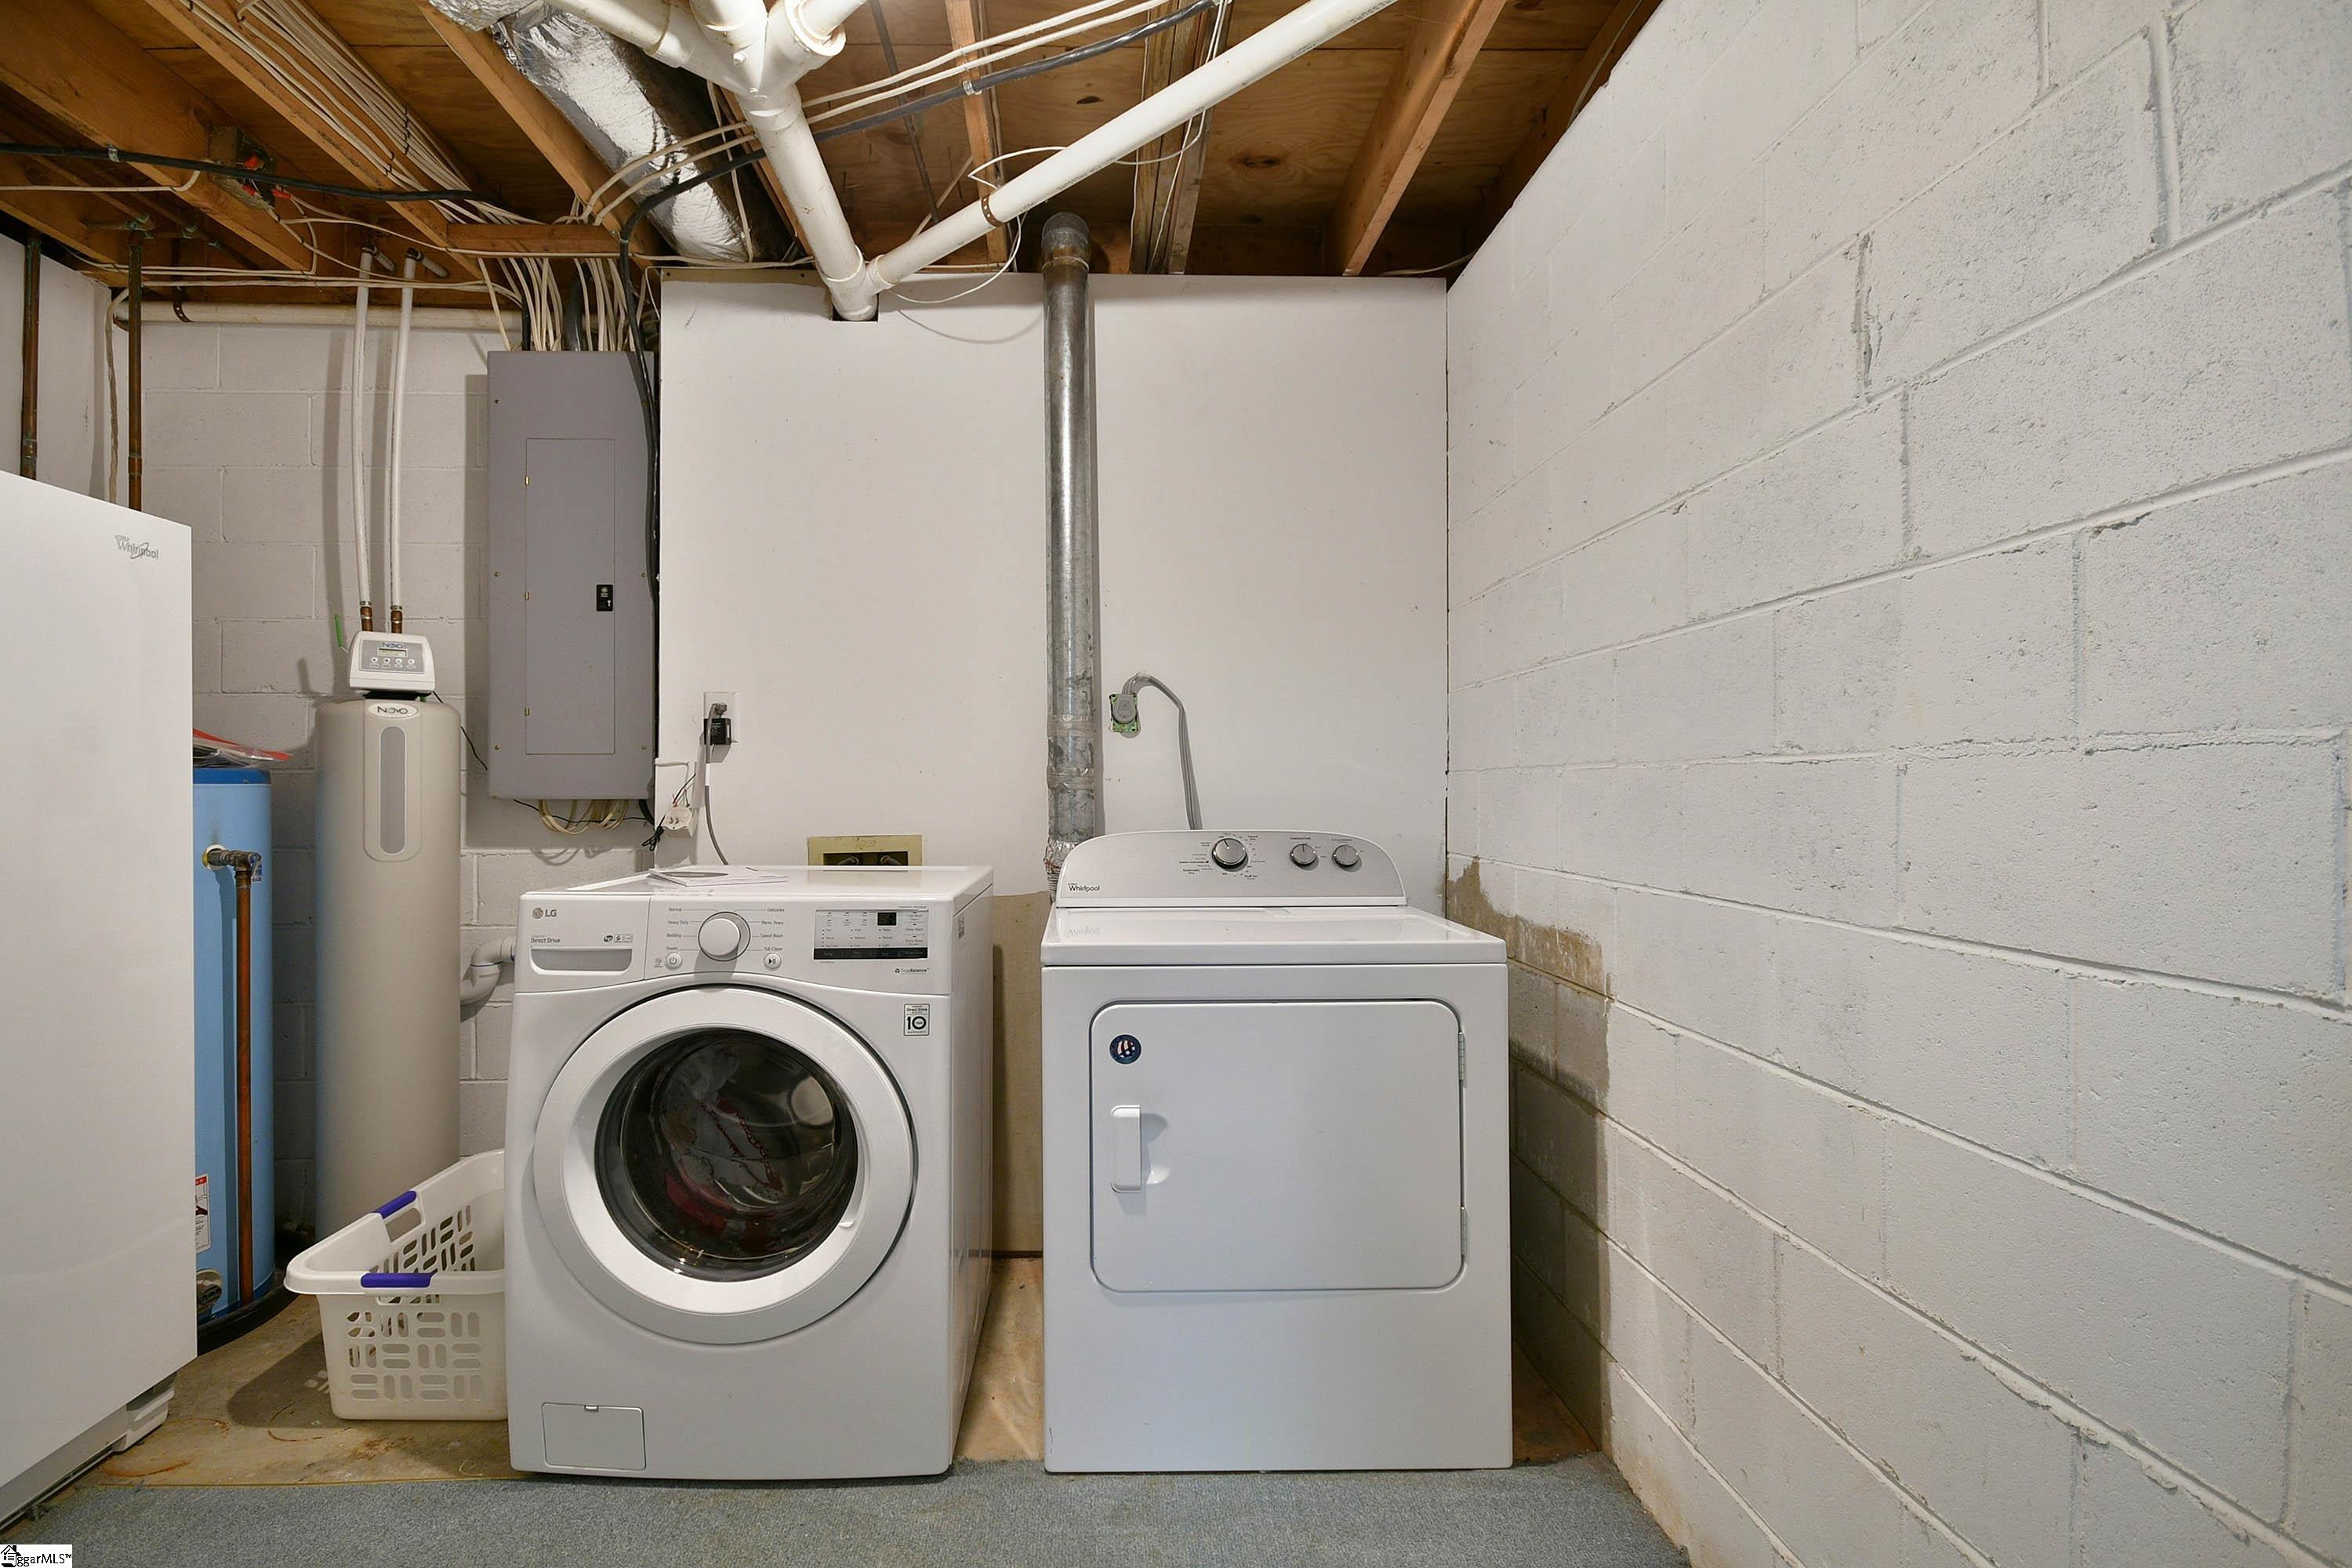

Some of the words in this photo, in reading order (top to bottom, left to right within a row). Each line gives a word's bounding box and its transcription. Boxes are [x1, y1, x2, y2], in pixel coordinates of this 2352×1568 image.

[117, 537, 159, 559] Whirlpool
[545, 909, 557, 917] LG
[906, 1015, 927, 1030] 10
